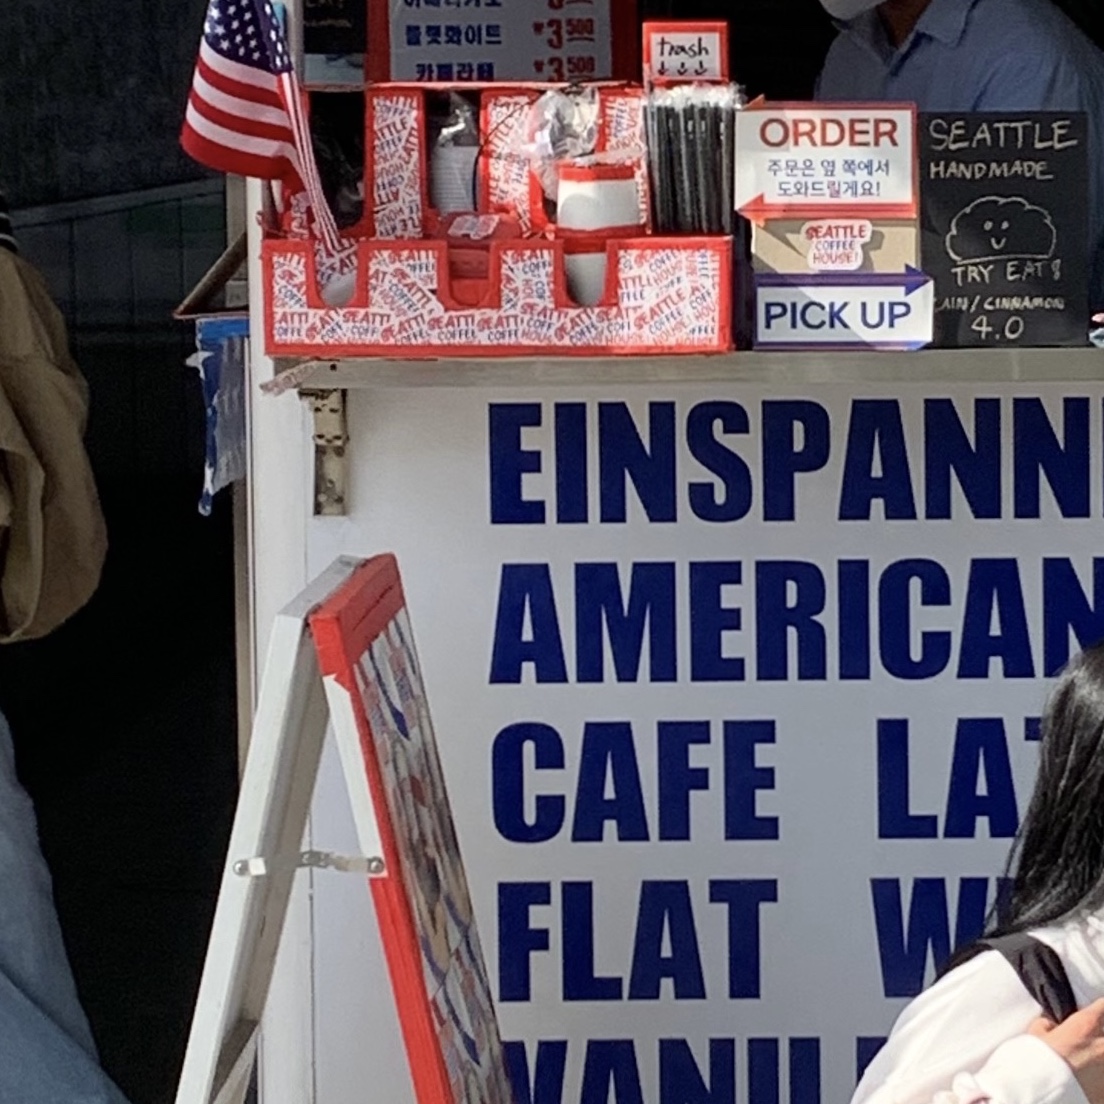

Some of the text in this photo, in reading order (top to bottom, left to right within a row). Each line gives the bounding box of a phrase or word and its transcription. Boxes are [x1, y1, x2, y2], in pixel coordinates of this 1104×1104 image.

[656, 36, 709, 58] trash
[759, 117, 899, 148] ORDER
[928, 118, 1079, 151] SEATTLE
[767, 158, 890, 178] 주문은 옆 쪽에서
[929, 160, 1054, 181] HANDMADE
[777, 180, 882, 198] 도와드릴게요!
[804, 224, 868, 241] SEATTLE
[812, 250, 860, 265] HOUSE!
[814, 240, 856, 252] COFFEE
[951, 263, 995, 287] TRY
[763, 301, 912, 330] PICK UP
[970, 315, 1025, 340] 4.0
[491, 716, 1043, 844] CAFE LA
[497, 878, 779, 1003] FLAT
